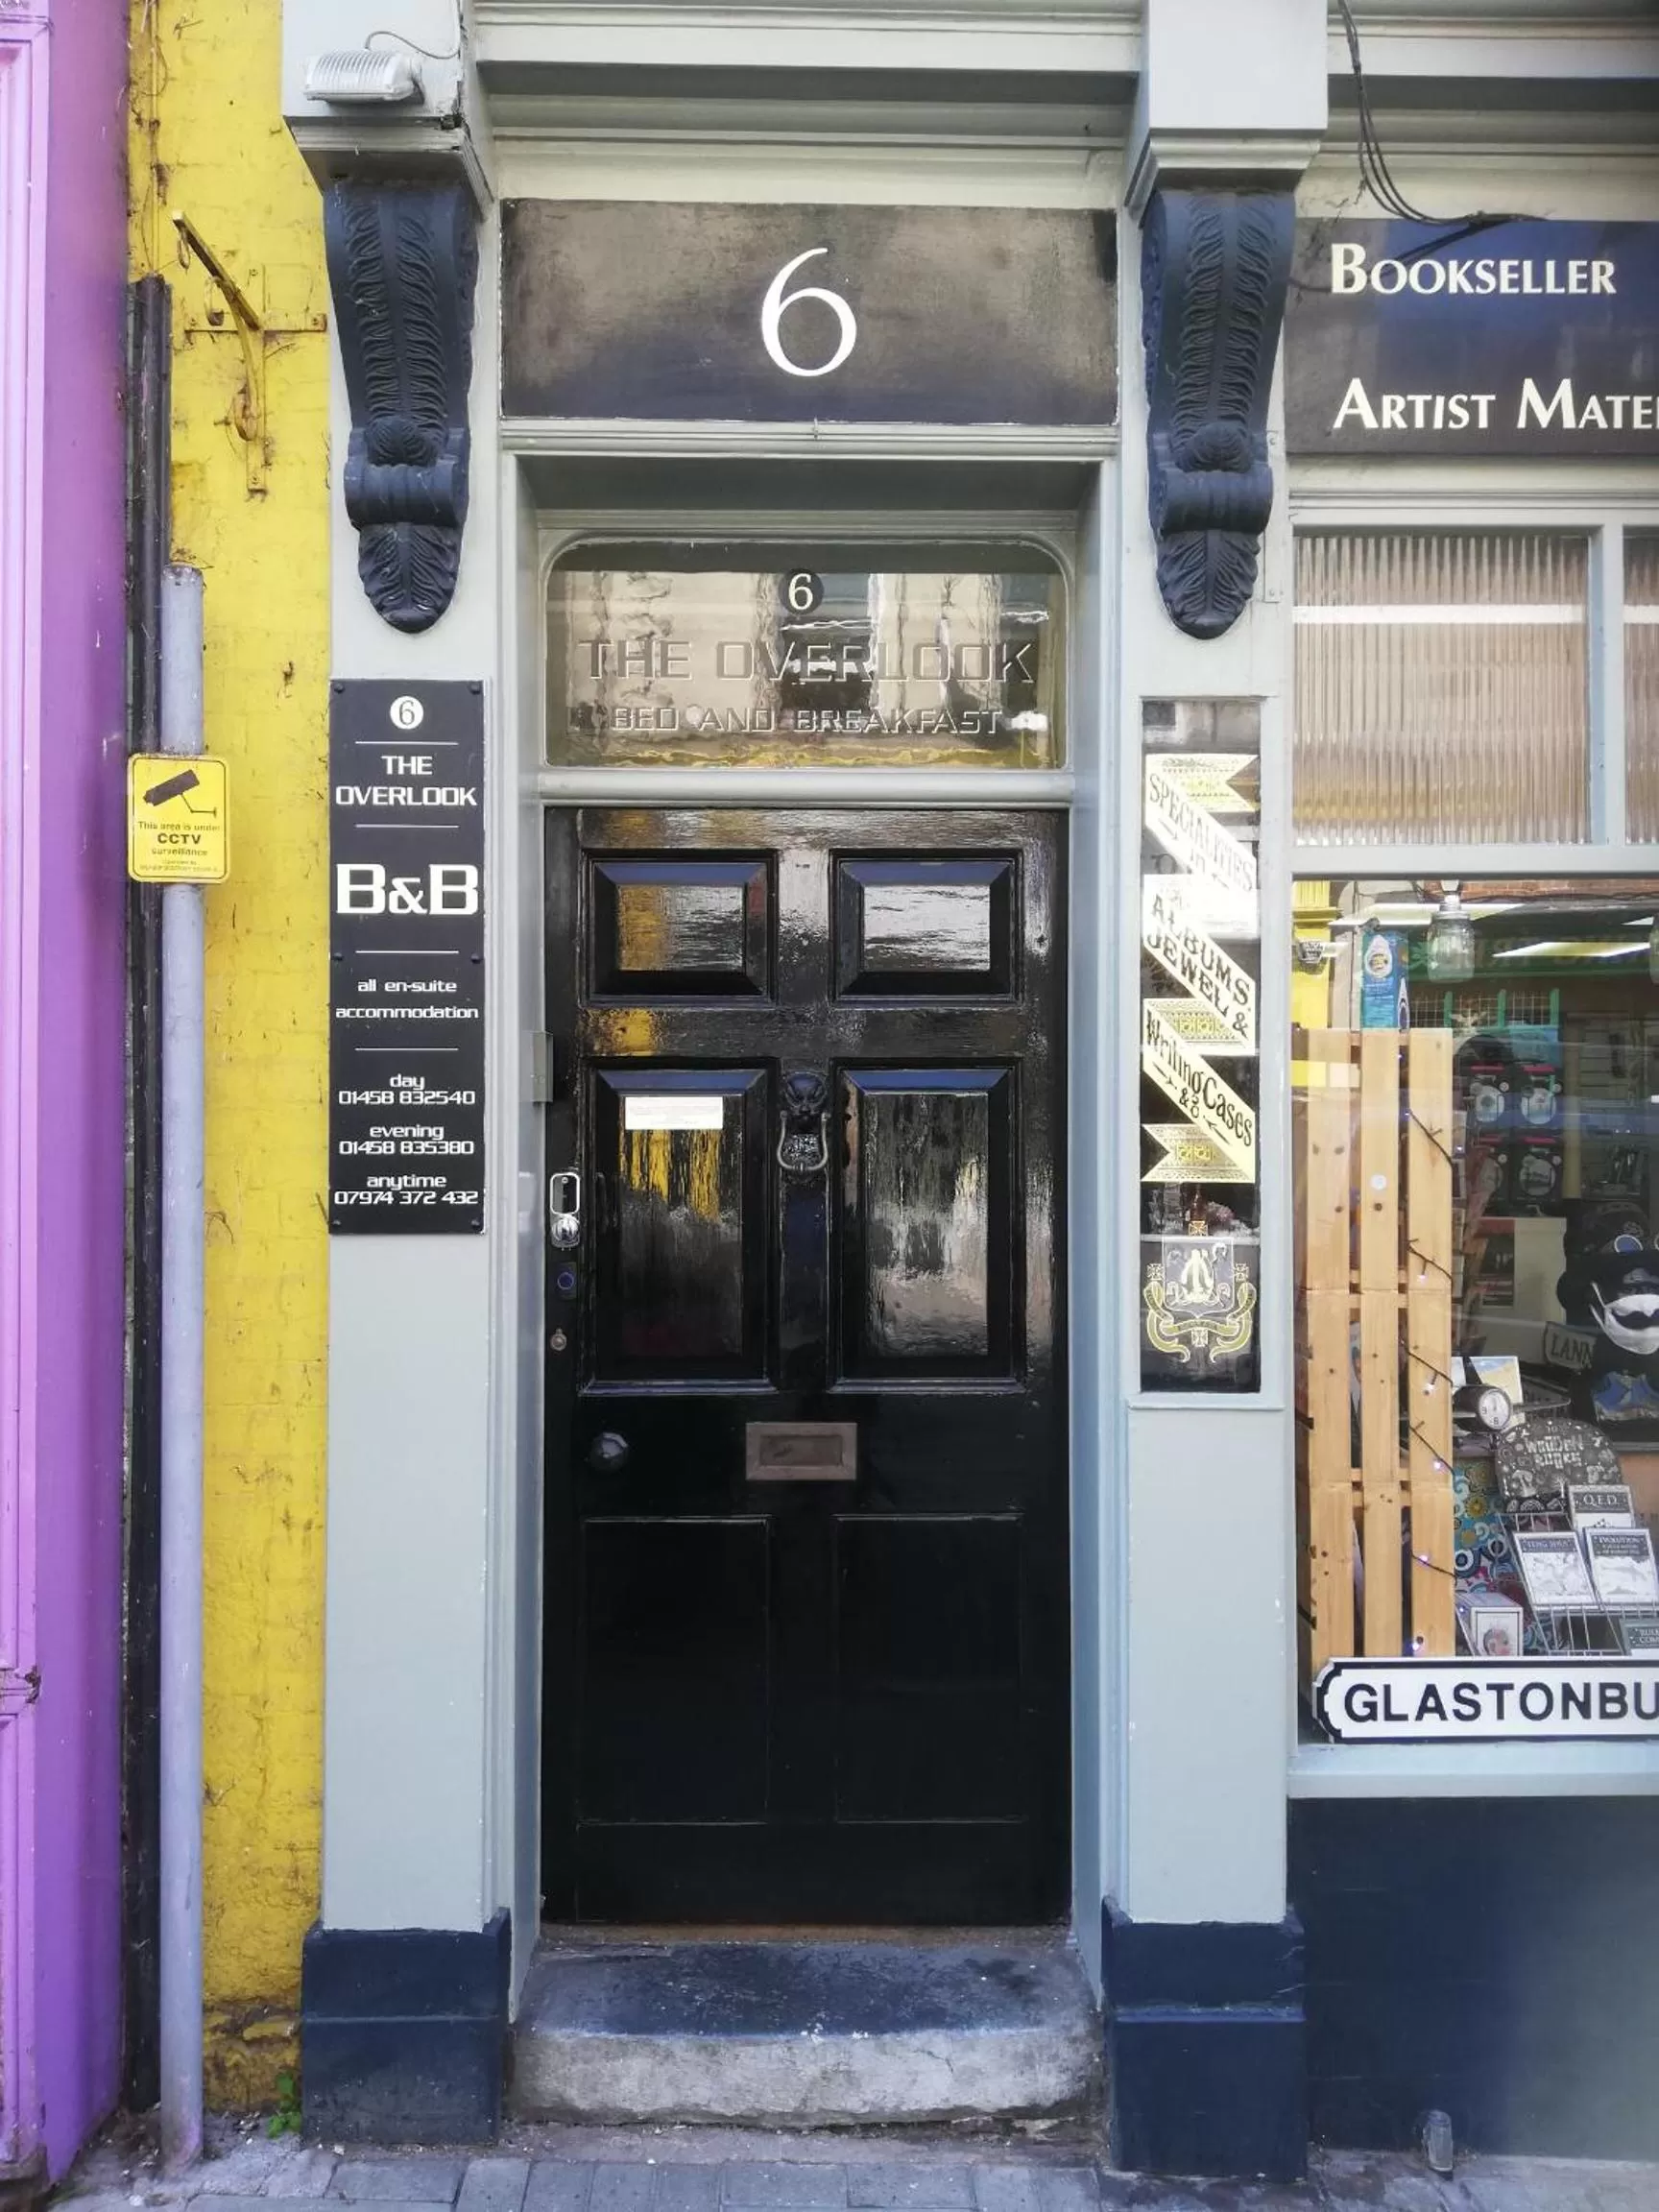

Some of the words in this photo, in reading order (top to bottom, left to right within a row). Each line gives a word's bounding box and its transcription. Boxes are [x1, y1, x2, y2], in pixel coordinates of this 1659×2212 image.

[1331, 242, 1617, 295] BOOKSELLER
[761, 247, 857, 376] 6
[1333, 376, 1496, 429] ARTIST
[1517, 377, 1659, 429] MATE
[786, 573, 814, 610] 6
[578, 639, 693, 680] THE
[716, 639, 1038, 684] OVERLOOK
[398, 700, 416, 725] 6
[613, 705, 679, 732] BED
[698, 705, 774, 733] AND
[795, 708, 1002, 735] BREAKFAST
[381, 755, 433, 776] THE
[335, 785, 478, 806] OVERLOOK
[138, 821, 158, 830] This
[160, 822, 181, 831] area
[156, 832, 203, 845] CCTV
[336, 863, 479, 915] B&B
[357, 978, 377, 993] all
[384, 978, 457, 993] en-suite
[335, 1005, 480, 1020] accommodation
[1232, 1011, 1250, 1041] &
[389, 1073, 425, 1091] day
[338, 1090, 396, 1105] 01458
[399, 1090, 476, 1105] 832540
[1202, 1075, 1253, 1147] Cases
[370, 1124, 445, 1141] evening
[339, 1141, 396, 1155] 01458
[400, 1141, 475, 1155] 835380
[367, 1173, 447, 1190] anytime
[334, 1190, 395, 1205] 07974
[398, 1190, 437, 1205] 372
[441, 1190, 479, 1205] 432
